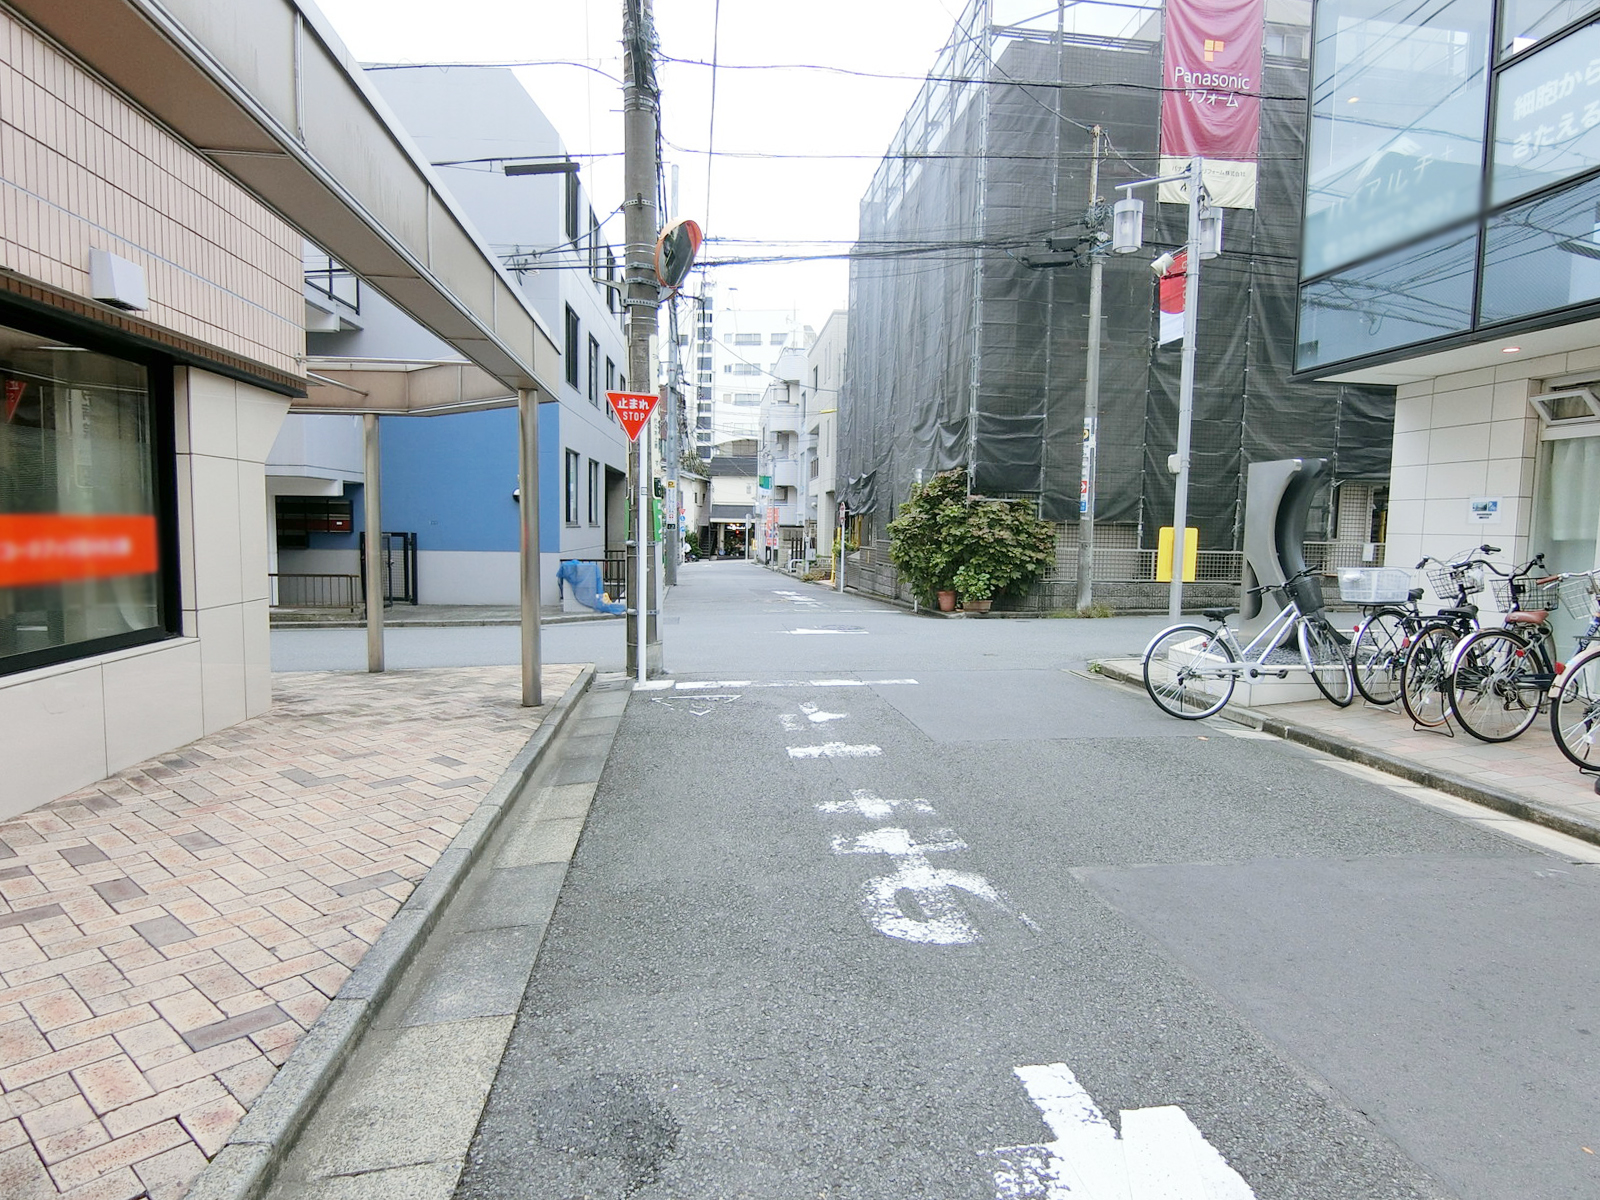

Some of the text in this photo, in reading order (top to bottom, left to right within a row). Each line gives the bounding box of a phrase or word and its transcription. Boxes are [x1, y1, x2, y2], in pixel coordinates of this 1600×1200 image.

[1174, 66, 1250, 90] Panasonic
[1513, 58, 1600, 121] 細胞から
[1185, 86, 1239, 108] リフォーム
[1513, 99, 1600, 159] きたえる
[617, 397, 650, 410] 止まれ
[622, 411, 646, 422] STOP
